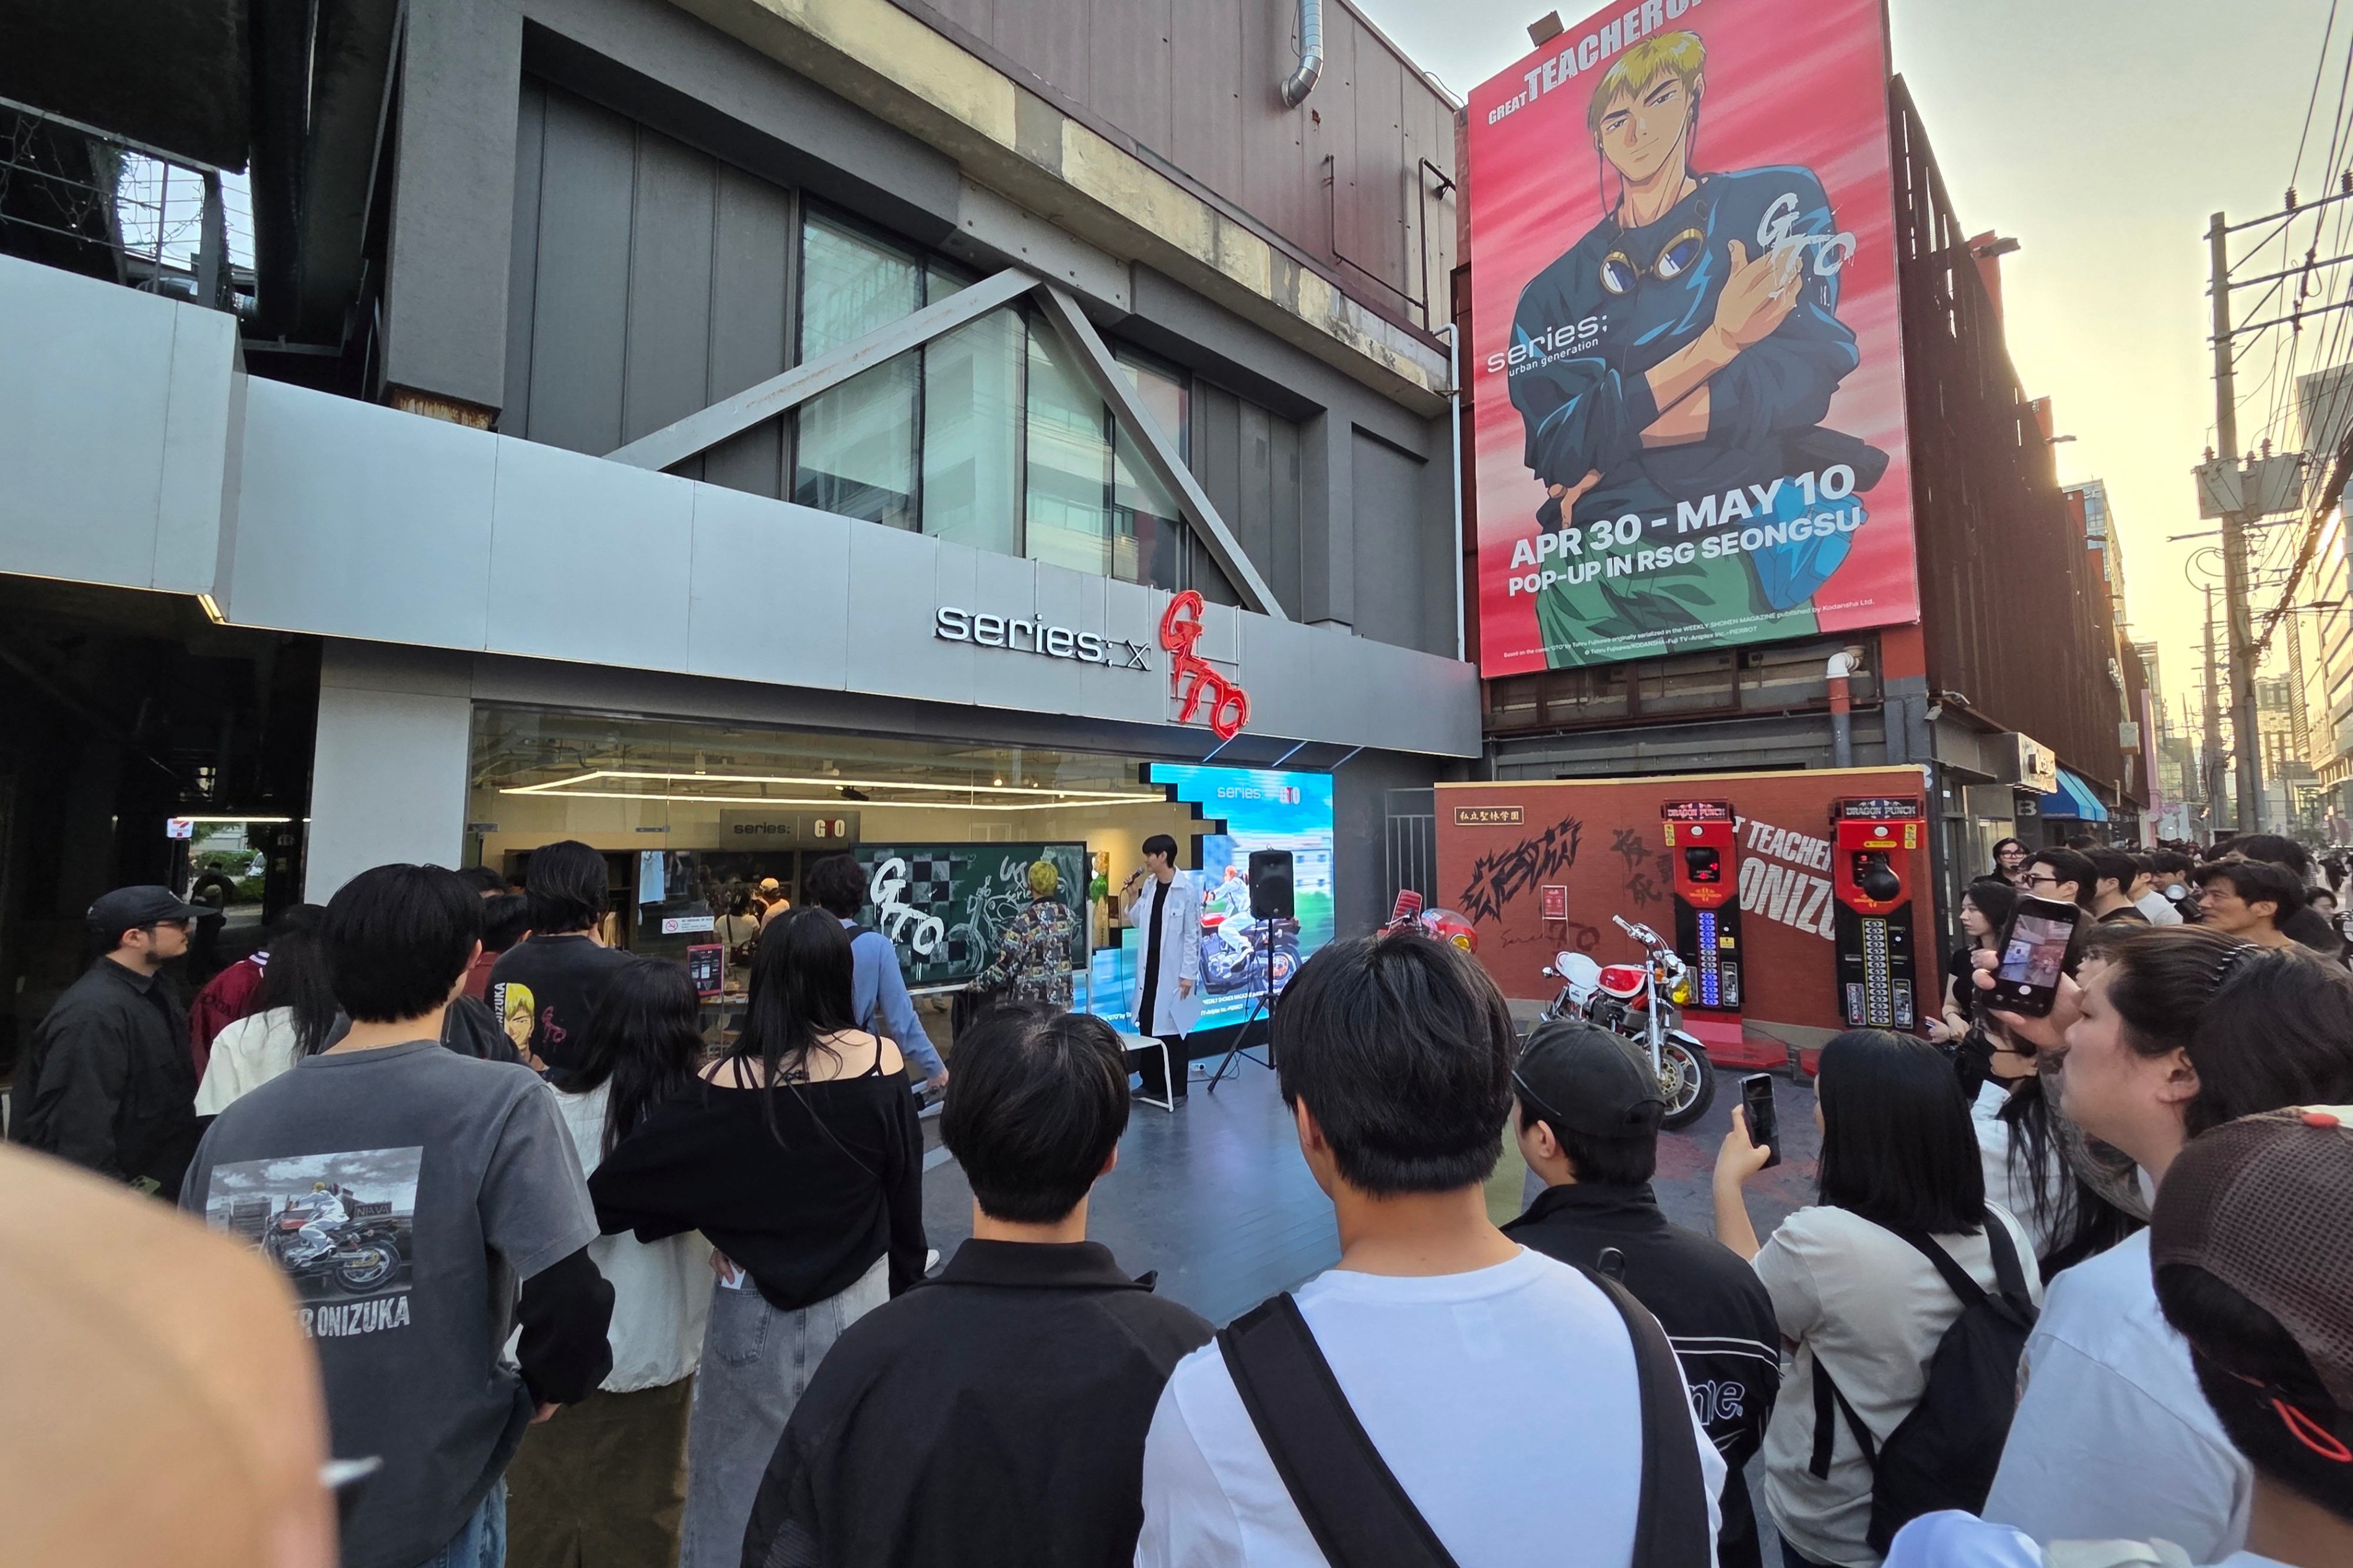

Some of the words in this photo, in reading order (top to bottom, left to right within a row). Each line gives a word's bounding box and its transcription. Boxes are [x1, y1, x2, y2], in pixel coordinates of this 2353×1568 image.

[1488, 91, 1527, 125] GREAT
[1756, 193, 1856, 300] GTO
[1487, 315, 1607, 373] series;
[1508, 360, 1538, 377] urban
[1541, 338, 1599, 367] generation
[1510, 528, 1581, 569] APR
[1590, 514, 1642, 552] 30
[1676, 475, 1784, 534] MAY
[1794, 464, 1855, 505] 10
[1508, 563, 1601, 597] POP-UP
[1606, 555, 1633, 578] IN
[1637, 542, 1695, 570] RSG
[1702, 507, 1861, 560] SEONGSU
[1612, 634, 1636, 643] originally
[1637, 630, 1664, 638] serialized
[1682, 622, 1709, 632] WEEKLY
[1710, 619, 1738, 628] SHONEN
[1739, 612, 1775, 624] MAGAZINE
[1777, 608, 1811, 619] published
[1822, 601, 1859, 611] Kodansha
[1860, 598, 1875, 606] Ltd.
[935, 606, 1114, 668] series;
[1161, 589, 1251, 741] GTO
[814, 819, 845, 838] GTO
[1668, 808, 1697, 816] DRAGON
[1699, 808, 1726, 816] PUNCH
[1845, 806, 1882, 816] DRAGON
[1884, 806, 1916, 815] PUNCH
[870, 856, 944, 957] GTO
[1004, 889, 1033, 903] serie
[542, 1006, 567, 1043] GTO
[317, 1296, 411, 1337] ONIZUKA
